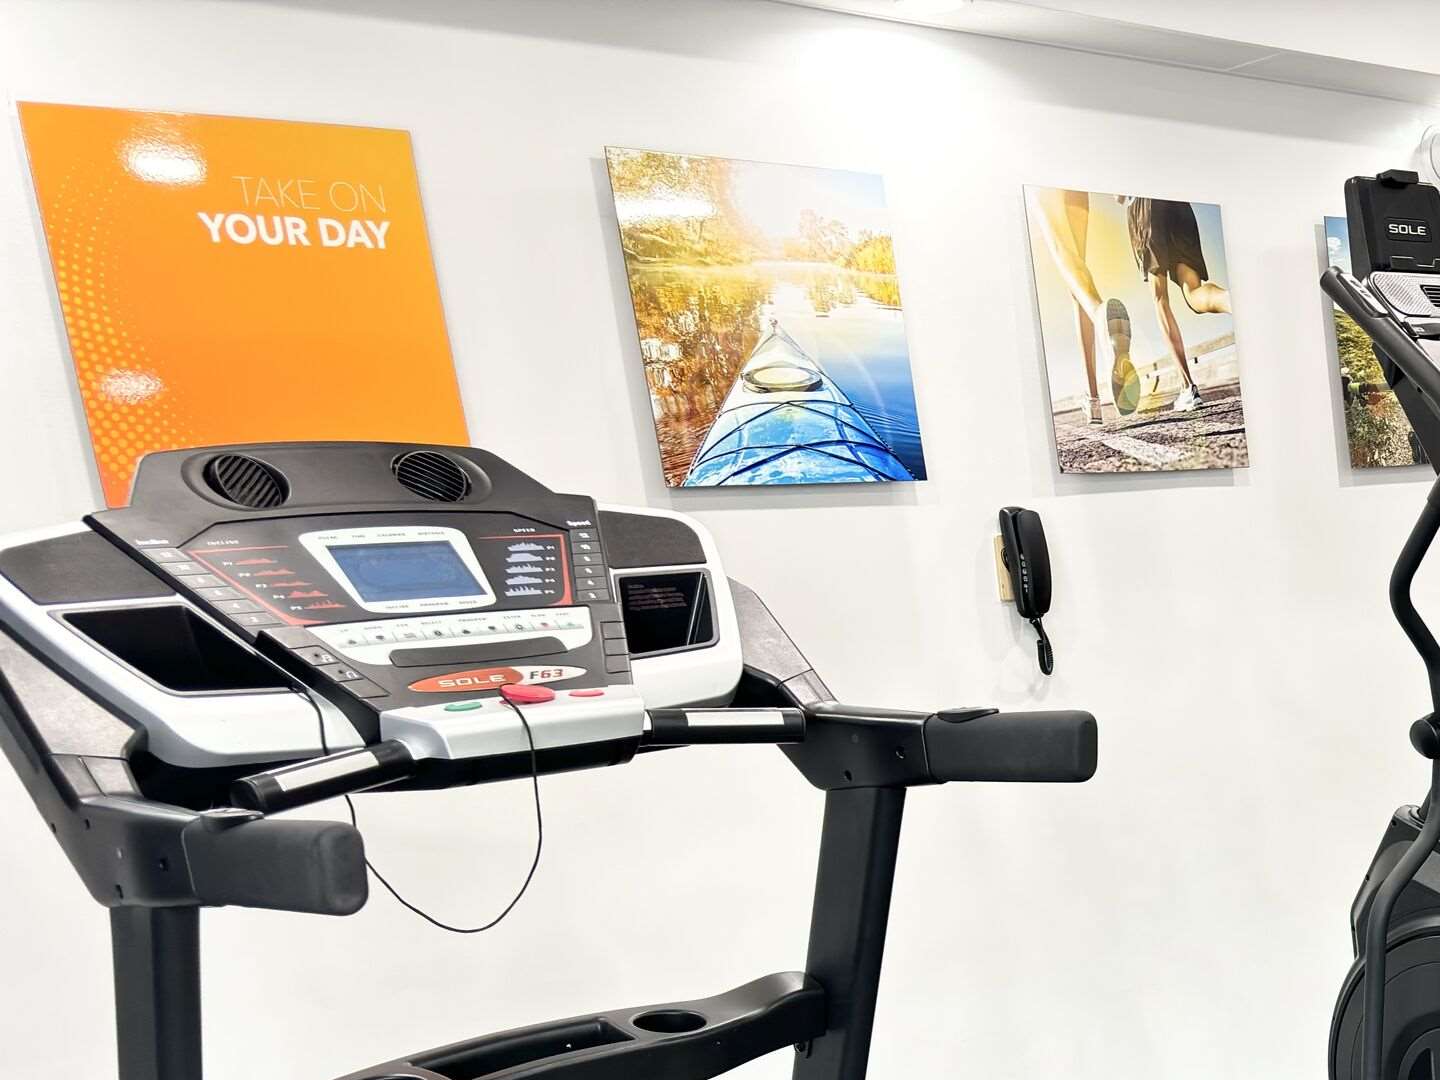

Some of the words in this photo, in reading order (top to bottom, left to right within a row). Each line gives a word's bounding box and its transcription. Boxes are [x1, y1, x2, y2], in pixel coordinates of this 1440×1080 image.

[231, 175, 321, 211] TAKE
[328, 181, 387, 214] ON
[196, 211, 312, 247] YOUR
[317, 217, 391, 250] DAY
[1388, 222, 1428, 236] SOLE
[437, 674, 508, 688] SOLE
[529, 669, 564, 680] F63
